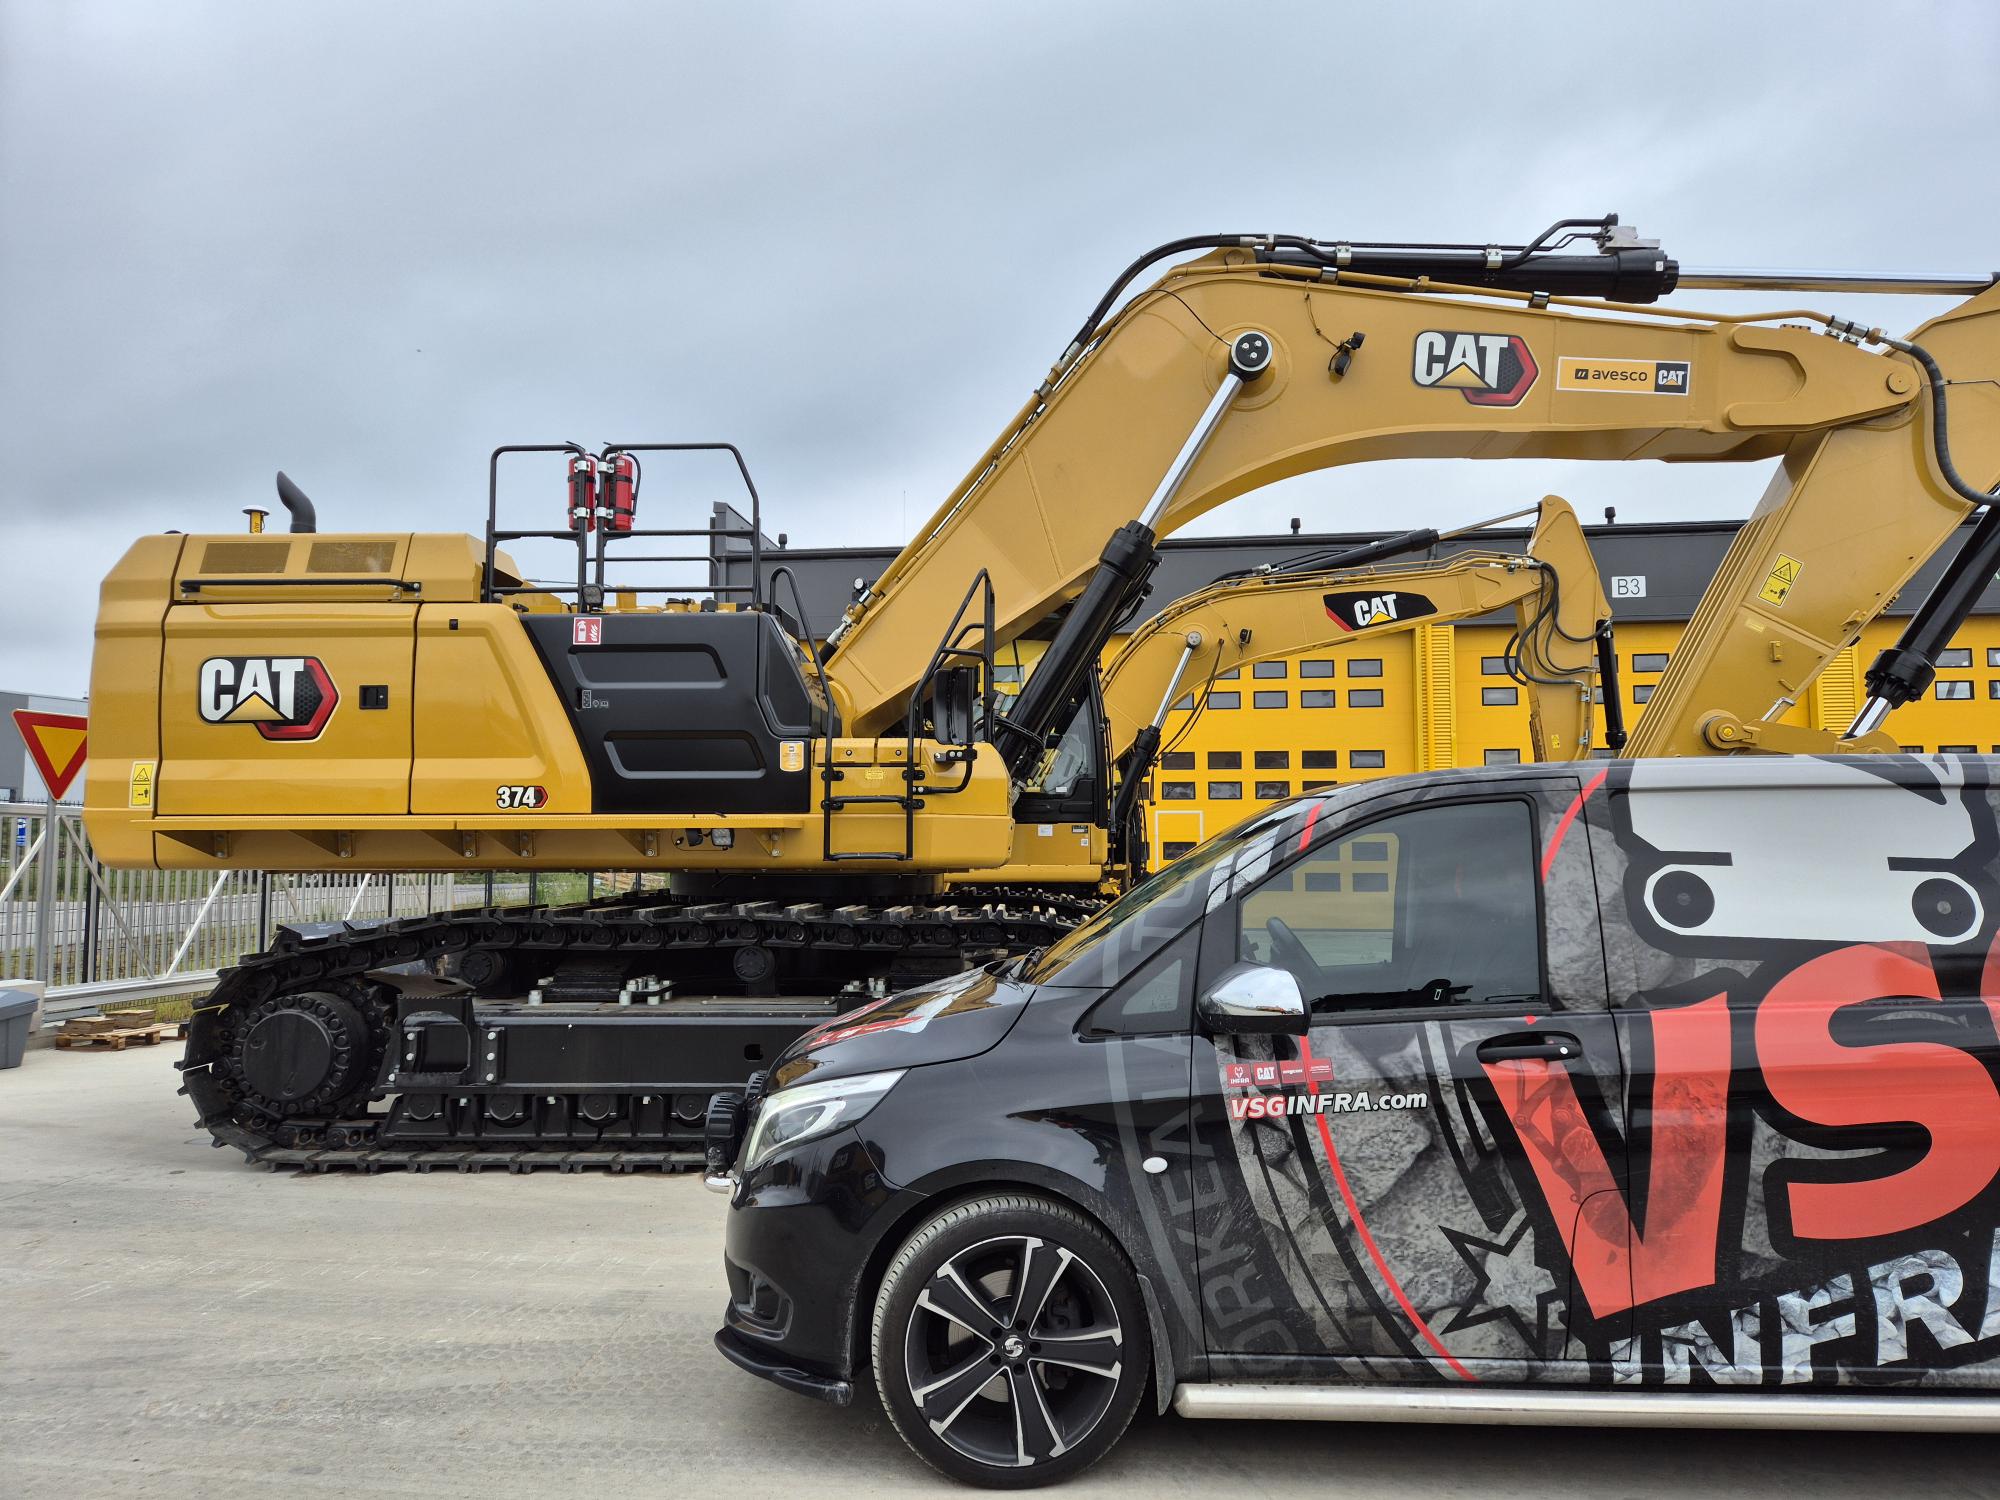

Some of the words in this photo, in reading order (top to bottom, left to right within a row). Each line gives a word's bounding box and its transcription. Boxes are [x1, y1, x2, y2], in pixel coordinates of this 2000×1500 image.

[1414, 331, 1509, 389] CAT
[1591, 369, 1648, 382] avesco
[1657, 369, 1685, 387] CAT
[1617, 578, 1640, 595] B3
[1353, 593, 1398, 627] CAT
[200, 658, 305, 721] CAT
[497, 786, 536, 808] 374
[1256, 1066, 1275, 1081] CAT
[1231, 1091, 1428, 1119] VSGINFRA.com
[1482, 930, 2000, 1319] VS
